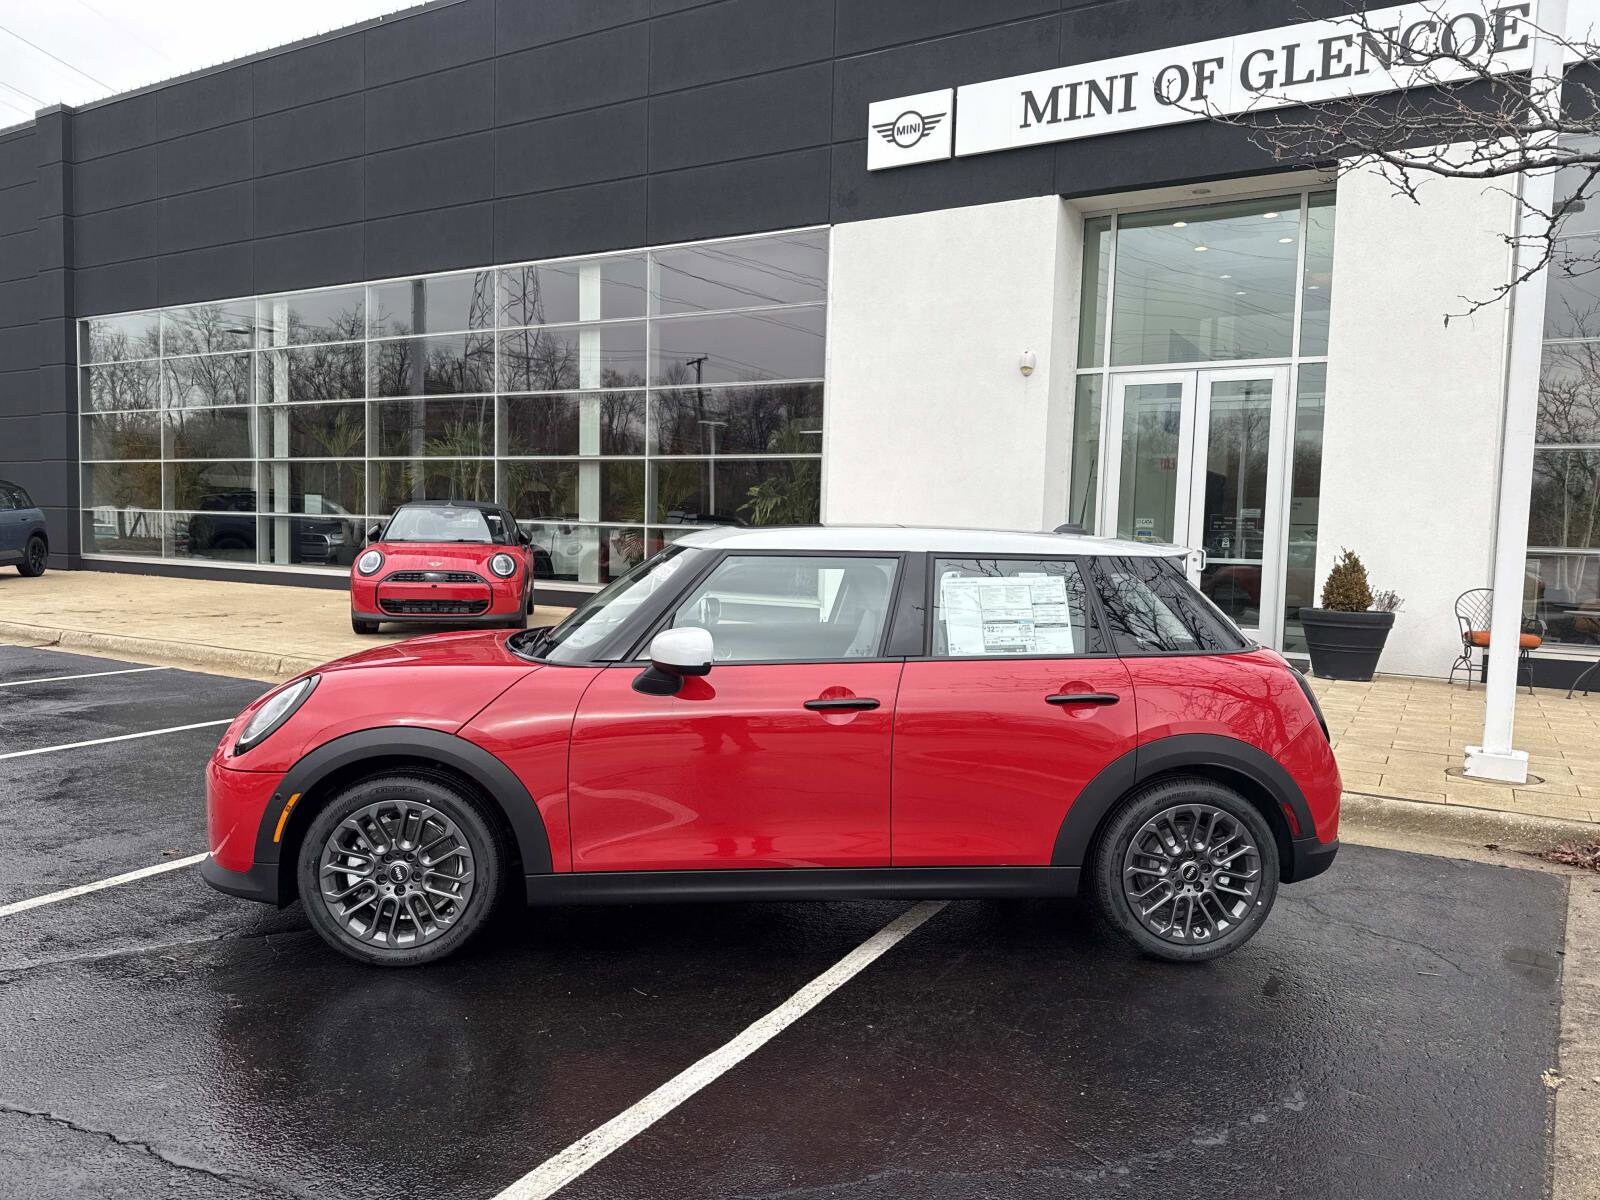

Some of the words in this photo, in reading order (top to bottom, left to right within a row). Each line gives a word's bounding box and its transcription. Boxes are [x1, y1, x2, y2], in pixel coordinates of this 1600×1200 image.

[1019, 72, 1139, 128] MINI
[1154, 57, 1224, 106] OF
[1239, 3, 1530, 92] GLENCOE
[896, 123, 920, 136] MINI
